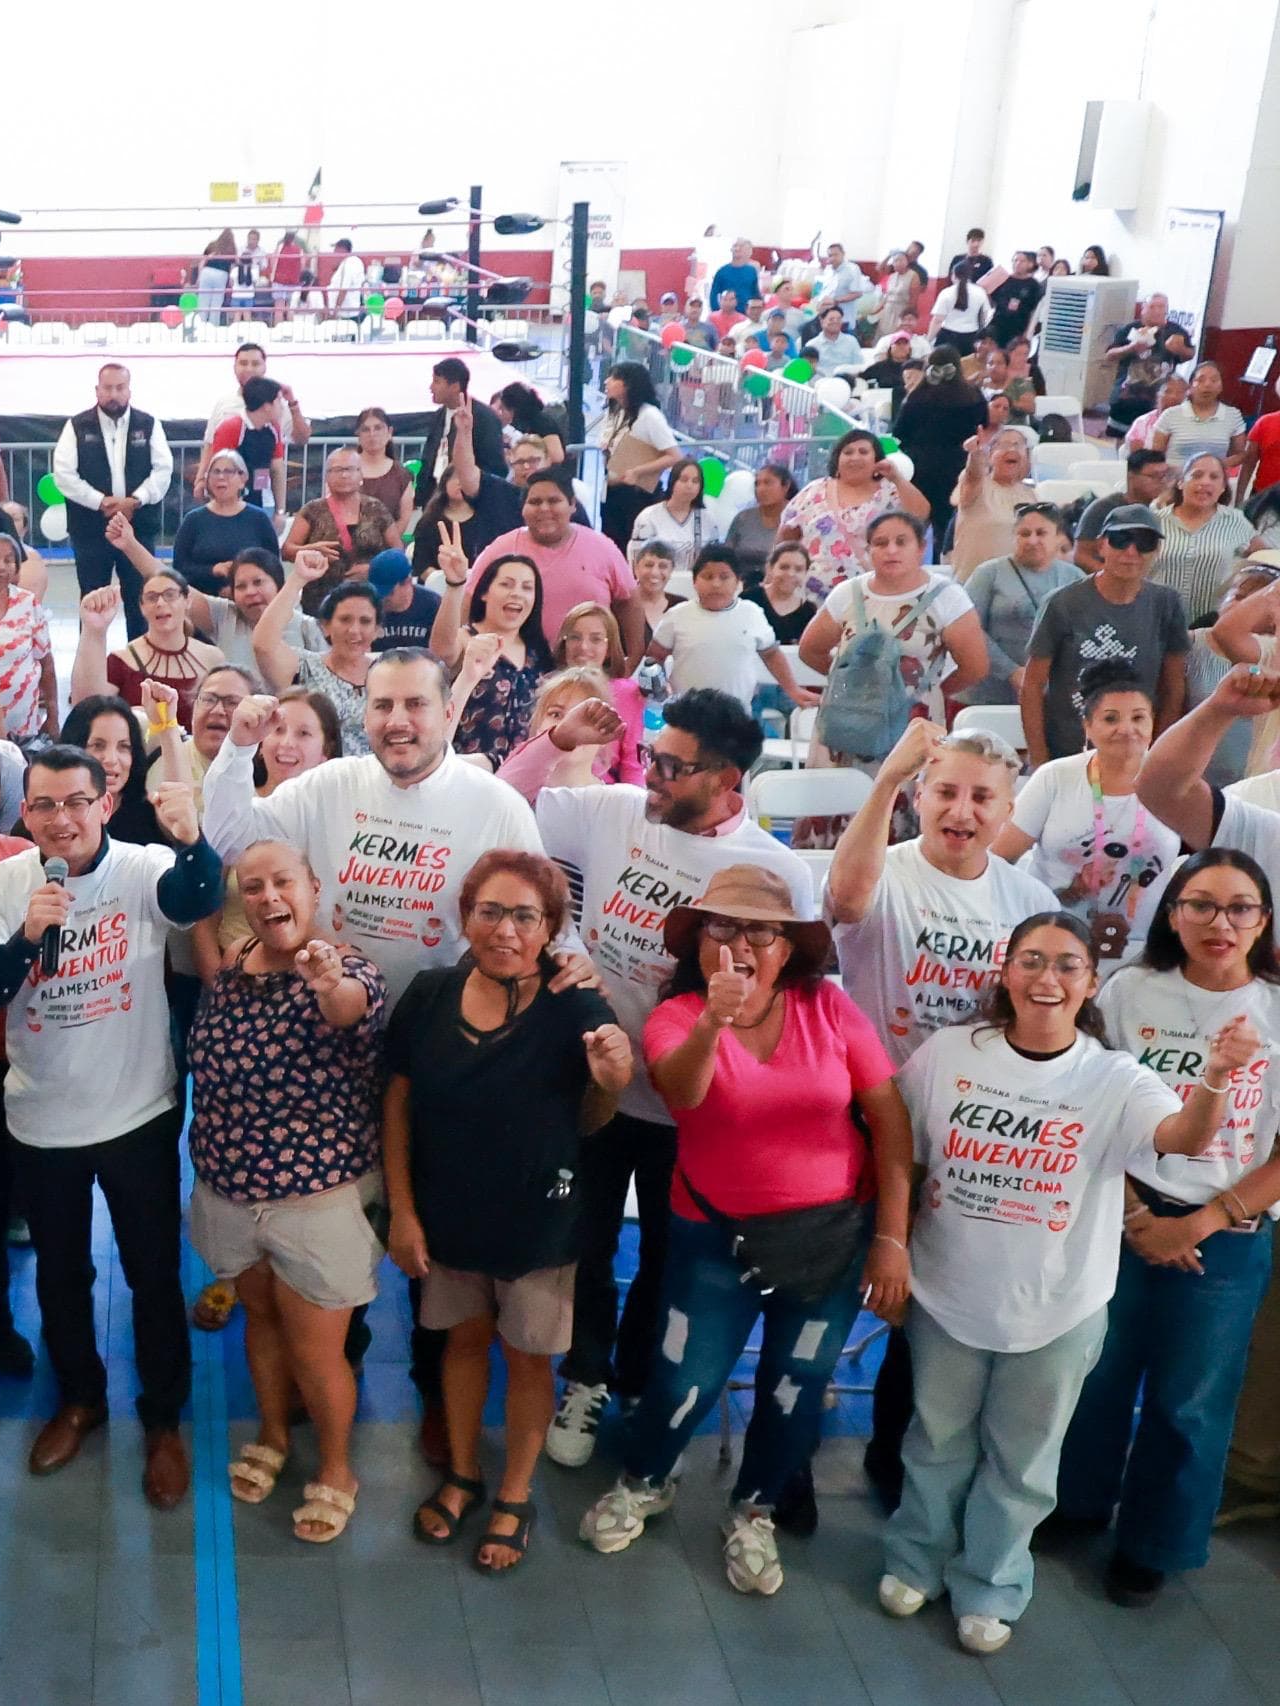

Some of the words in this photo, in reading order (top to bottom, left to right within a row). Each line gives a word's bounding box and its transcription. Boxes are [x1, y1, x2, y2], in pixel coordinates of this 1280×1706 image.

[349, 830, 451, 870] KERMÉS
[338, 855, 446, 893] JUVENTUD
[61, 912, 126, 953] RMÉS
[630, 934, 669, 957] MEXI
[28, 939, 128, 988] JVENTUD
[949, 1100, 1084, 1149] KERMÉS
[943, 1128, 1078, 1175] JUVENTUD
[947, 1167, 955, 1179] A
[980, 1172, 1062, 1195] MEXICANA
